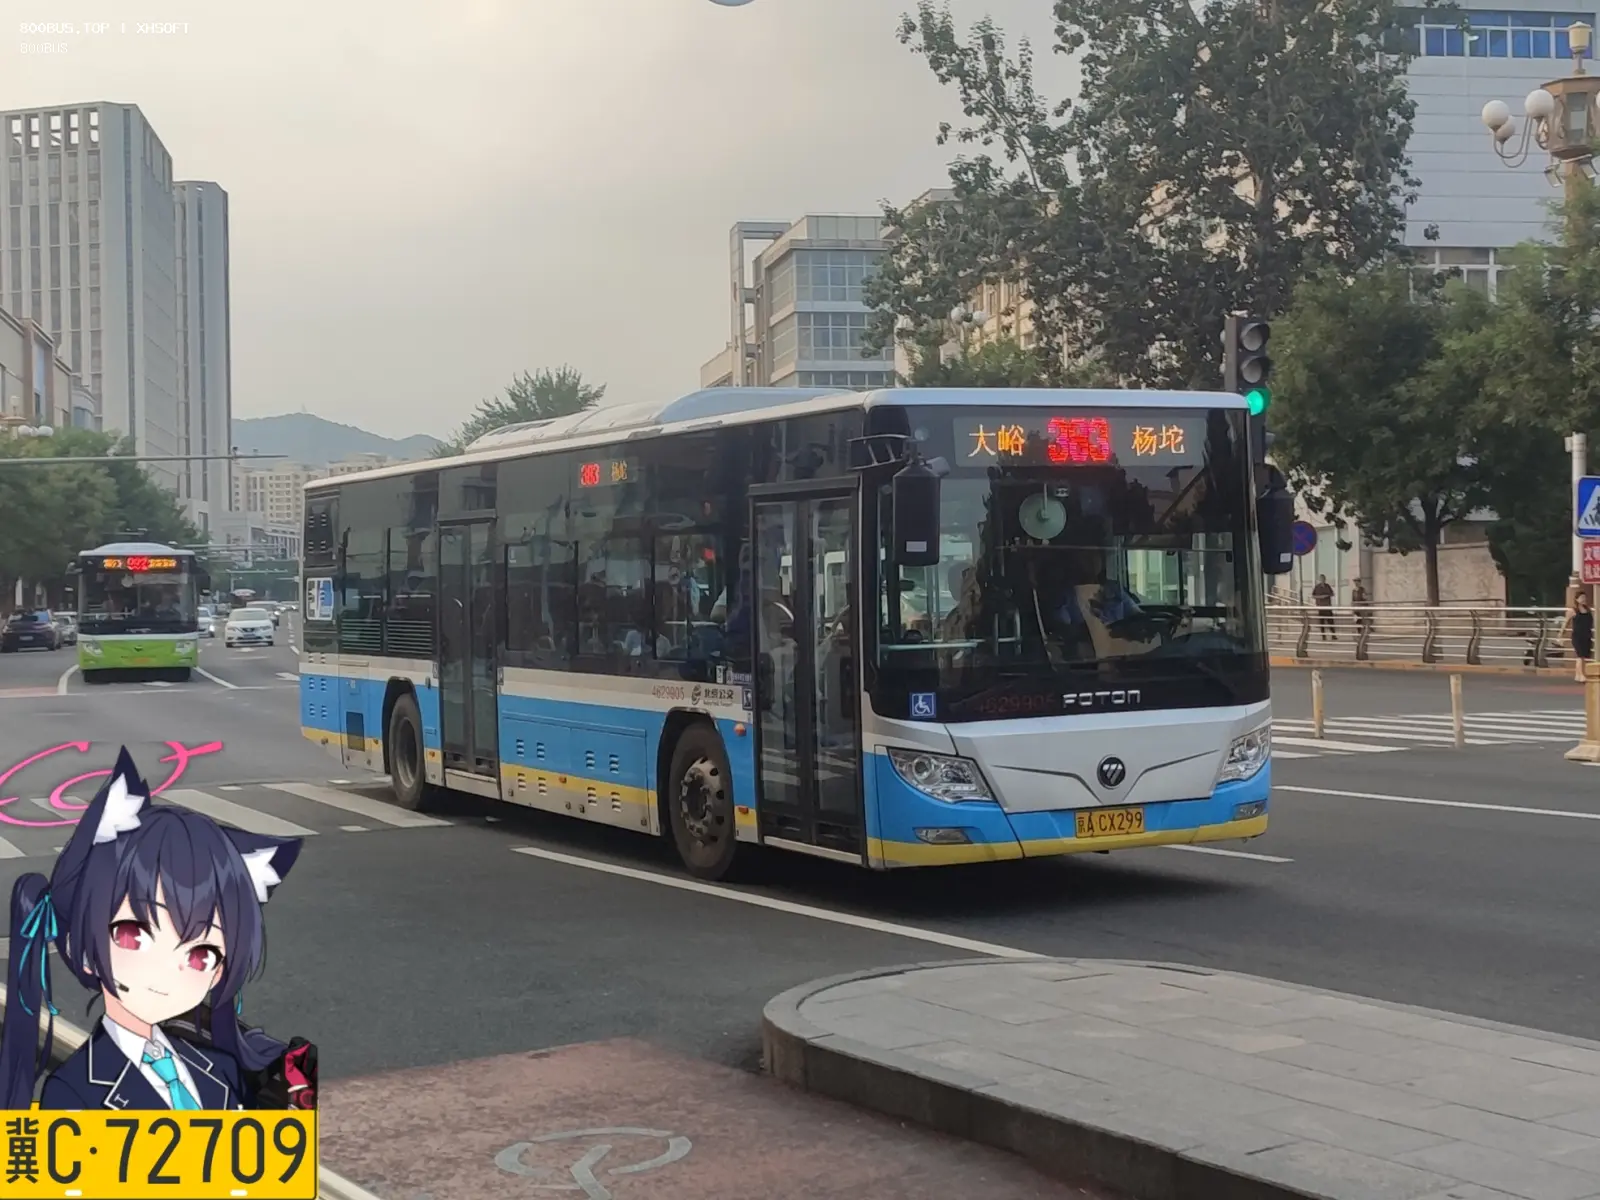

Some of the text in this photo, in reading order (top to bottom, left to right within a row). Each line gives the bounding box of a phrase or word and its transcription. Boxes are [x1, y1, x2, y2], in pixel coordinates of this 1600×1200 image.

[968, 417, 1186, 462] 大峪 383 杨坨
[1062, 689, 1141, 709] FOTON
